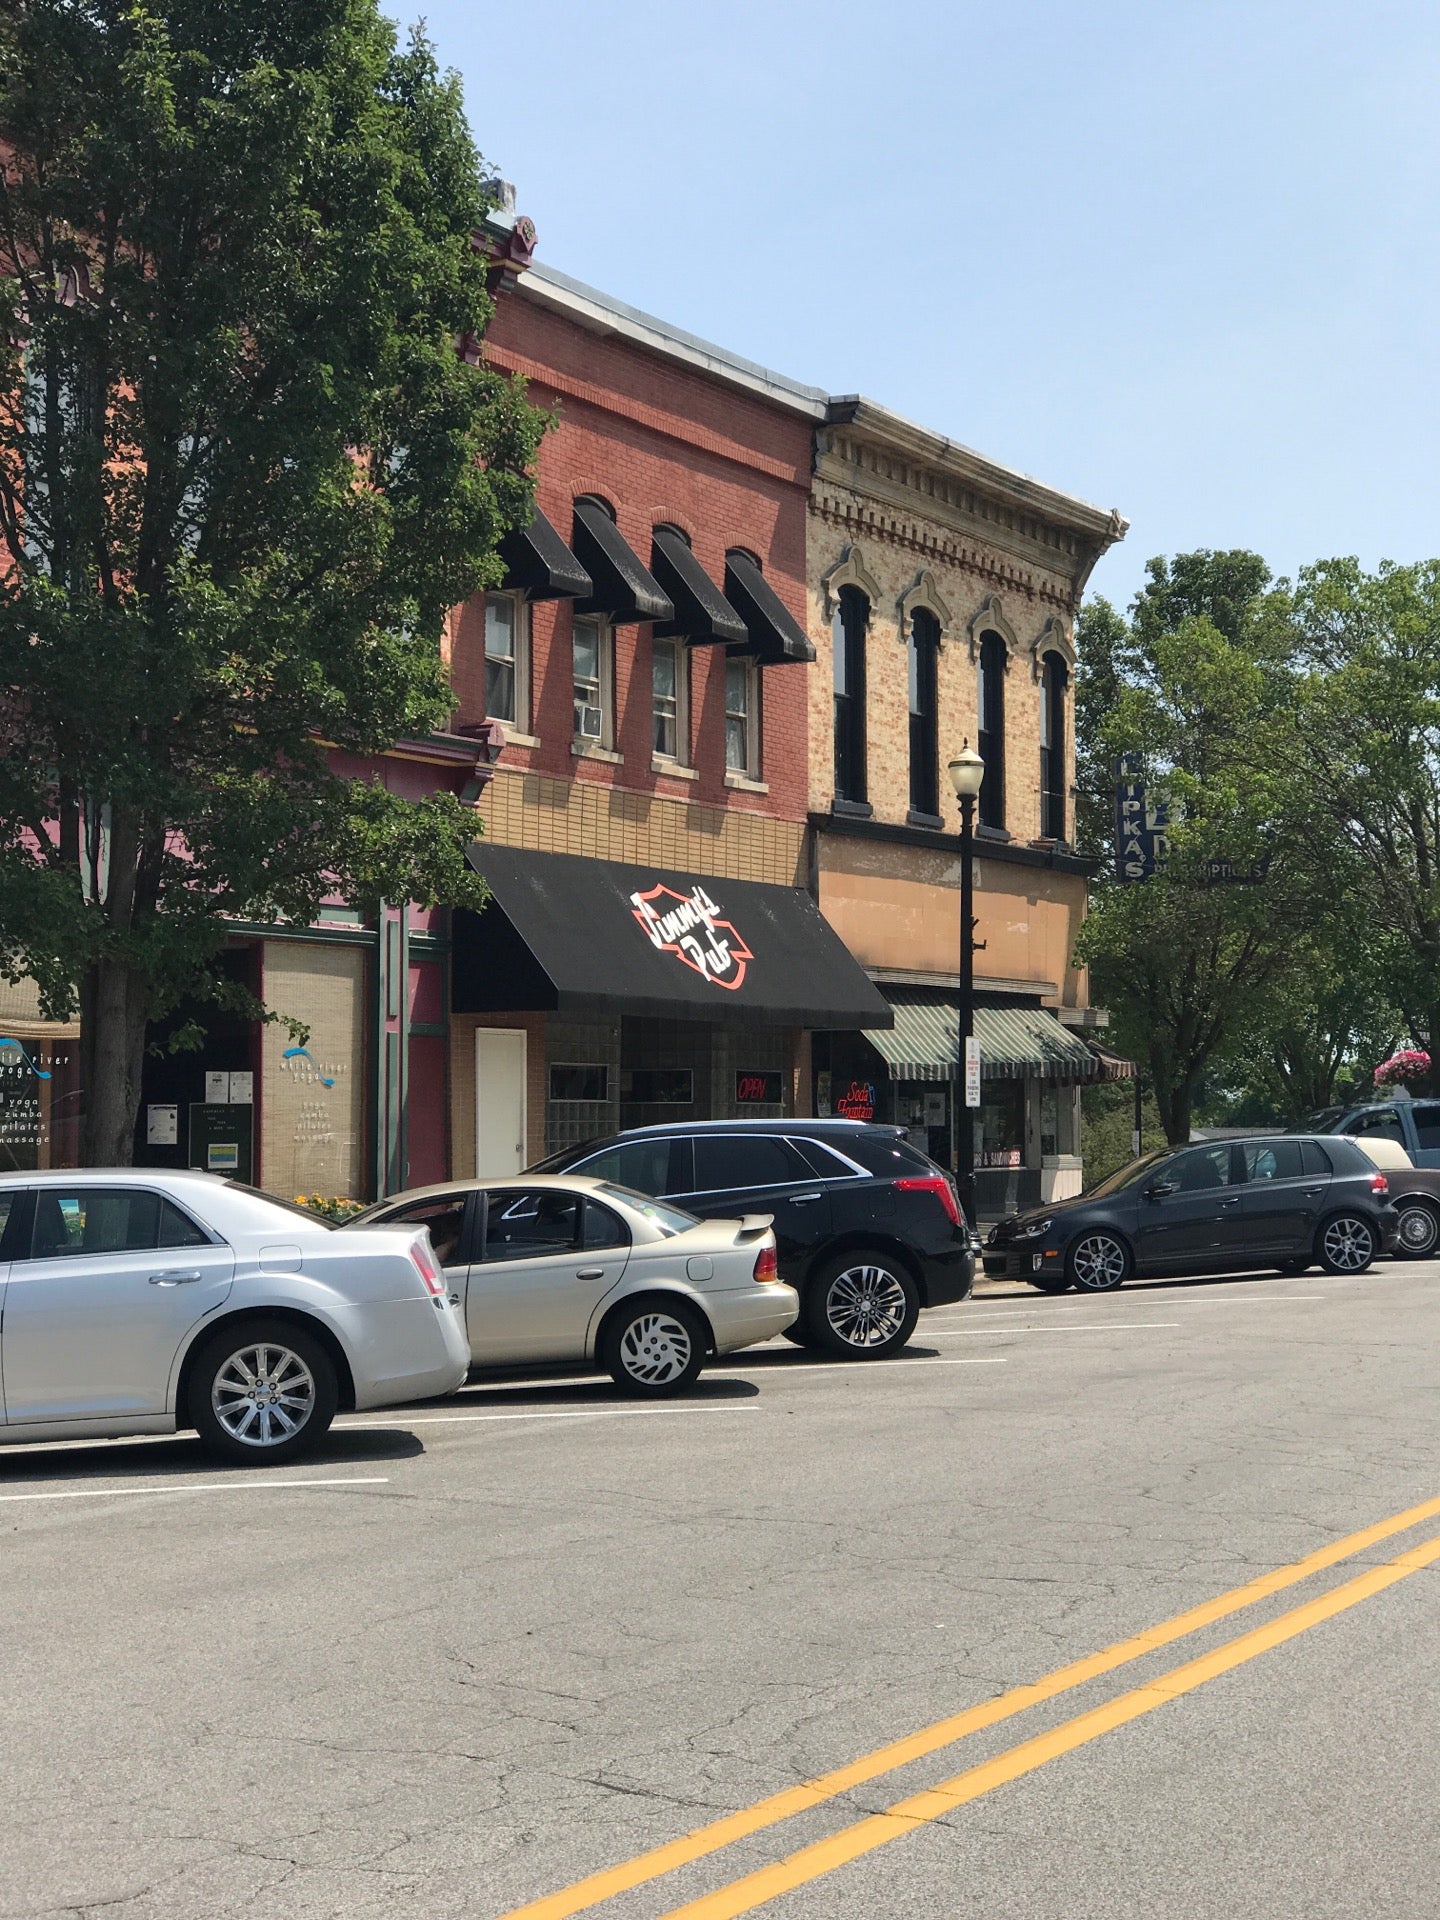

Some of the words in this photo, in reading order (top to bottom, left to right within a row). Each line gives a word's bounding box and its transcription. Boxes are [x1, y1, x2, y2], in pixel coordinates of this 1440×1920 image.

[629, 886, 721, 949] Jimmy's
[679, 930, 731, 981] Pub
[32, 1053, 69, 1065] river
[280, 1060, 312, 1071] white
[319, 1061, 347, 1071] river
[0, 1067, 32, 1079] yoga
[293, 1073, 320, 1084] yoga
[738, 1078, 766, 1098] OPEN
[846, 1081, 868, 1101] Soda
[9, 1099, 38, 1108] yoga
[837, 1099, 874, 1118] Fountain
[5, 1108, 42, 1118] zumba
[1, 1121, 46, 1133] pilates
